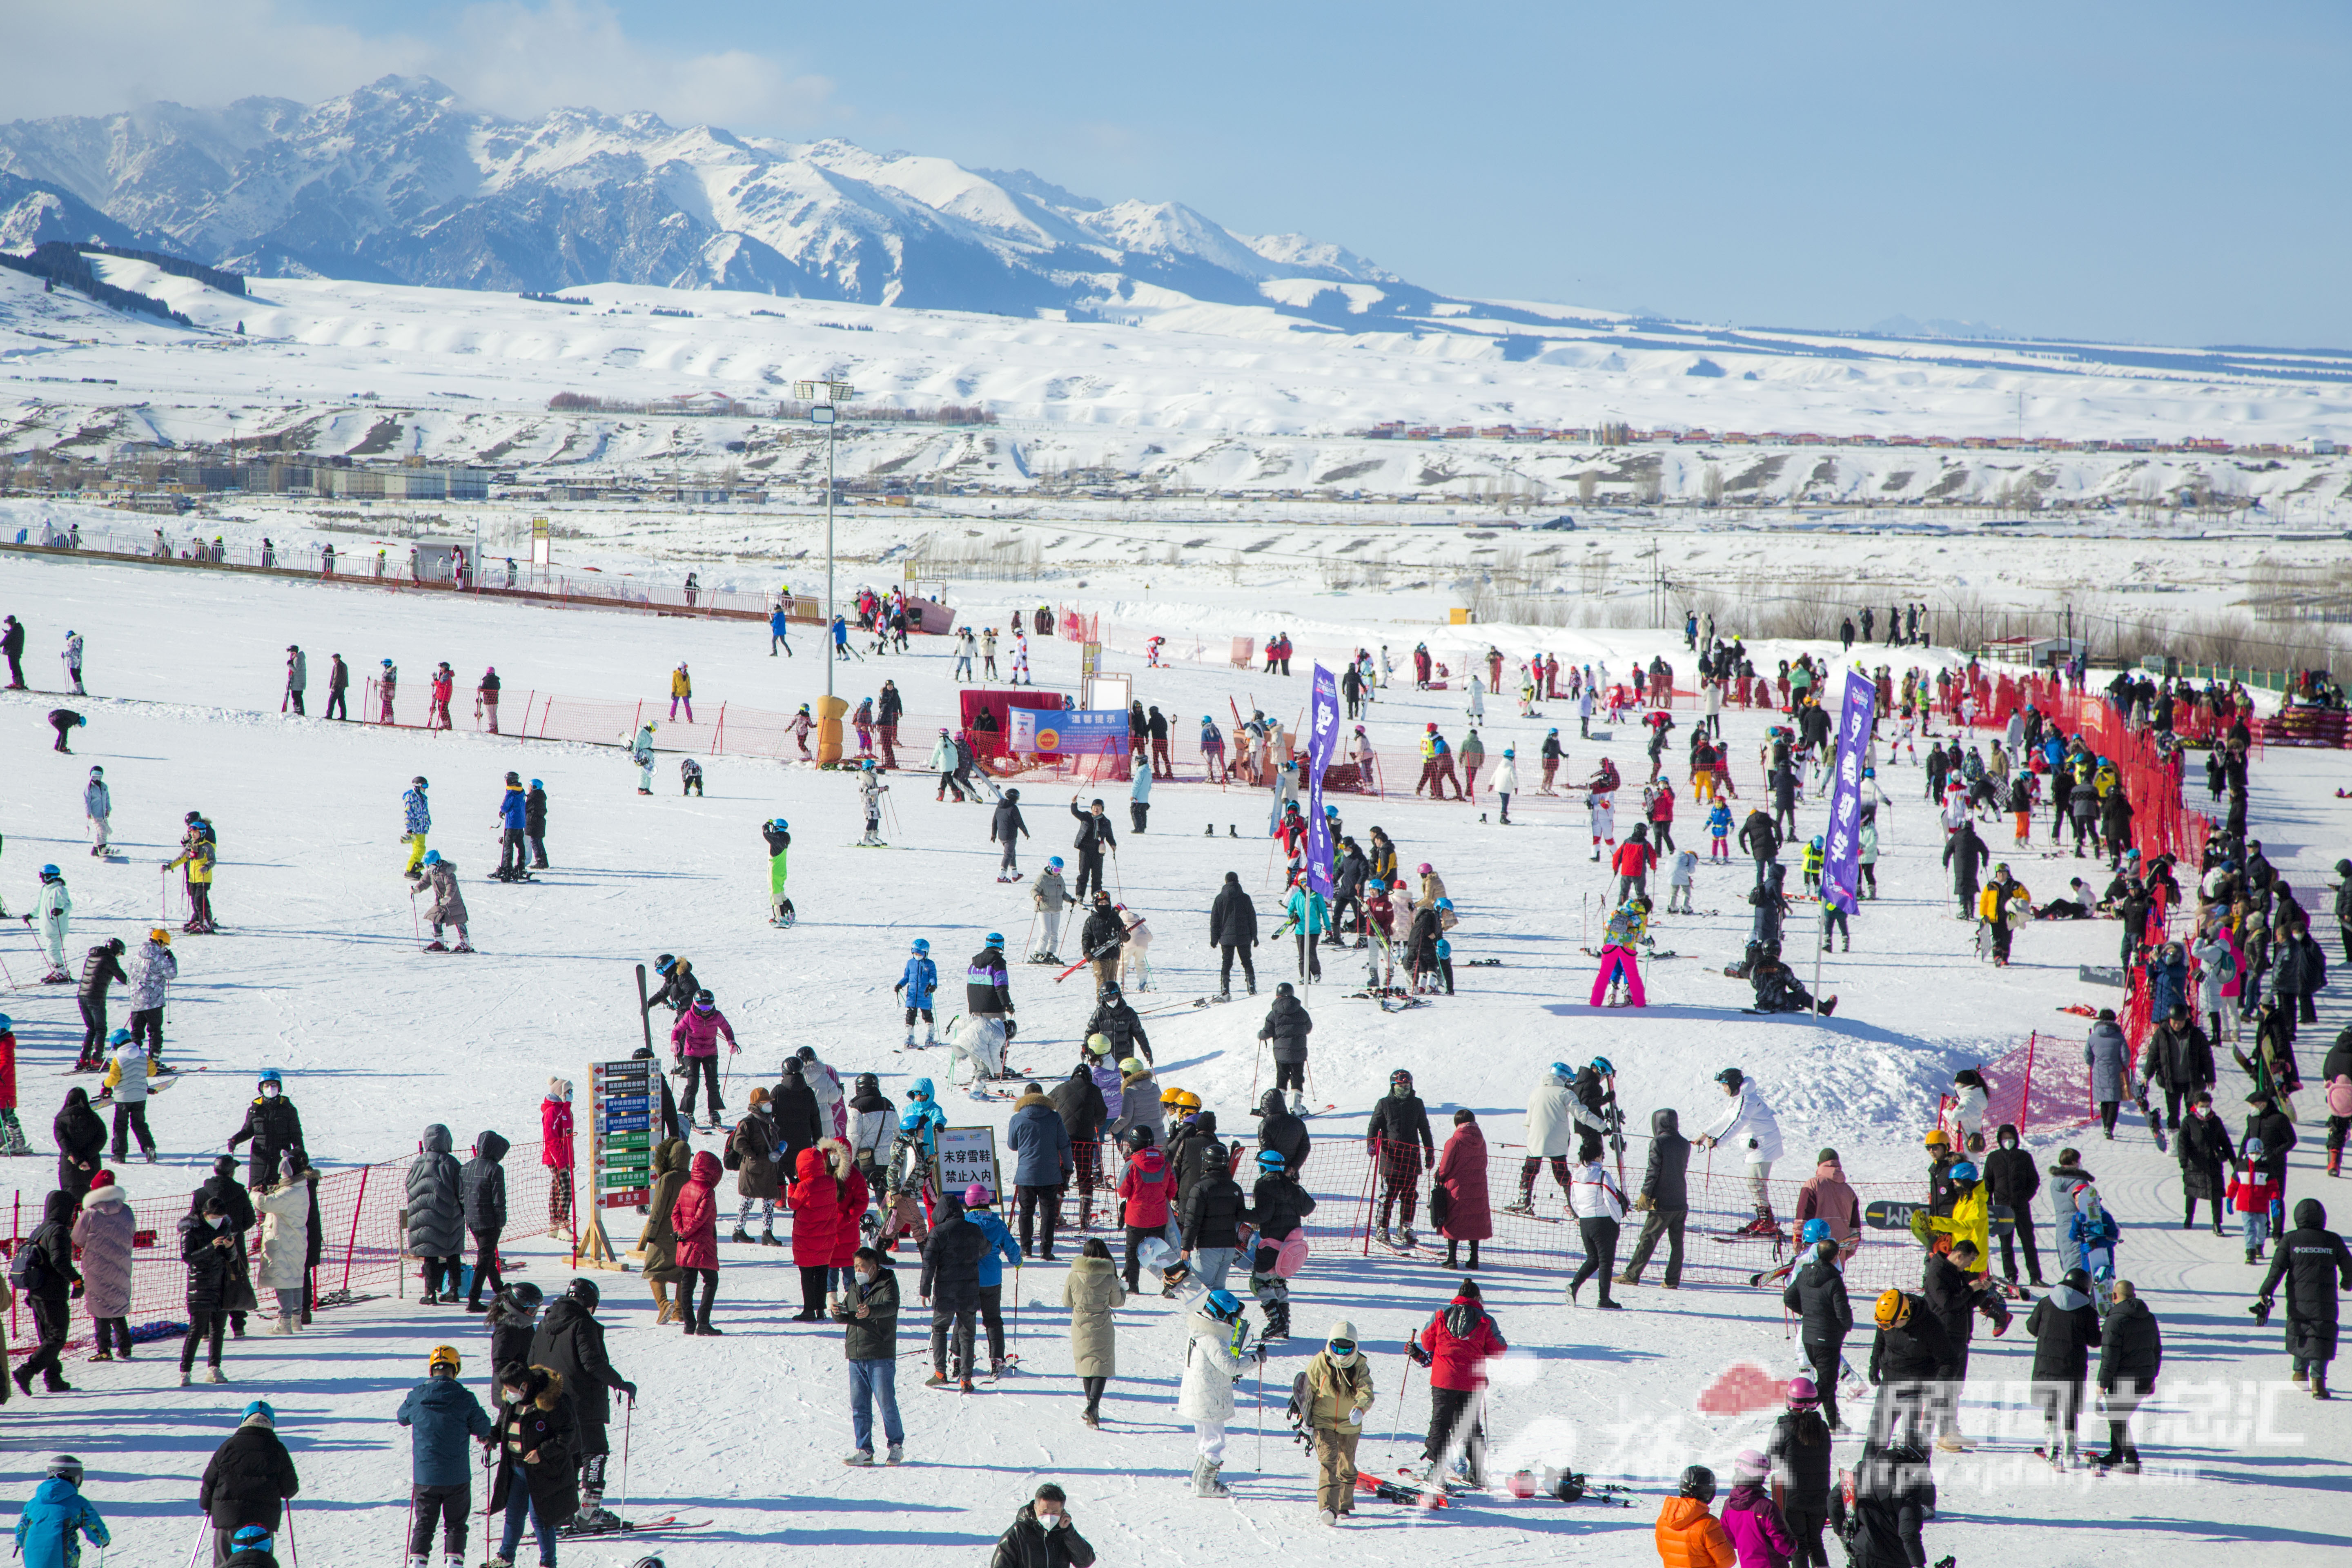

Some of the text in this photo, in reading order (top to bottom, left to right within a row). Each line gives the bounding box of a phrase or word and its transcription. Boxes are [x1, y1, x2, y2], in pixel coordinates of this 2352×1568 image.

[1071, 715, 1116, 724] 温馨提示
[608, 1080, 646, 1089] 限高级滑雪者使用
[609, 1098, 646, 1107] 限中级滑雪者使用
[609, 1116, 646, 1125] 限中级滑雪者使用
[944, 1149, 991, 1164] 未穿雪鞋
[945, 1169, 991, 1183] 禁止入内
[618, 1193, 639, 1202] 医务室
